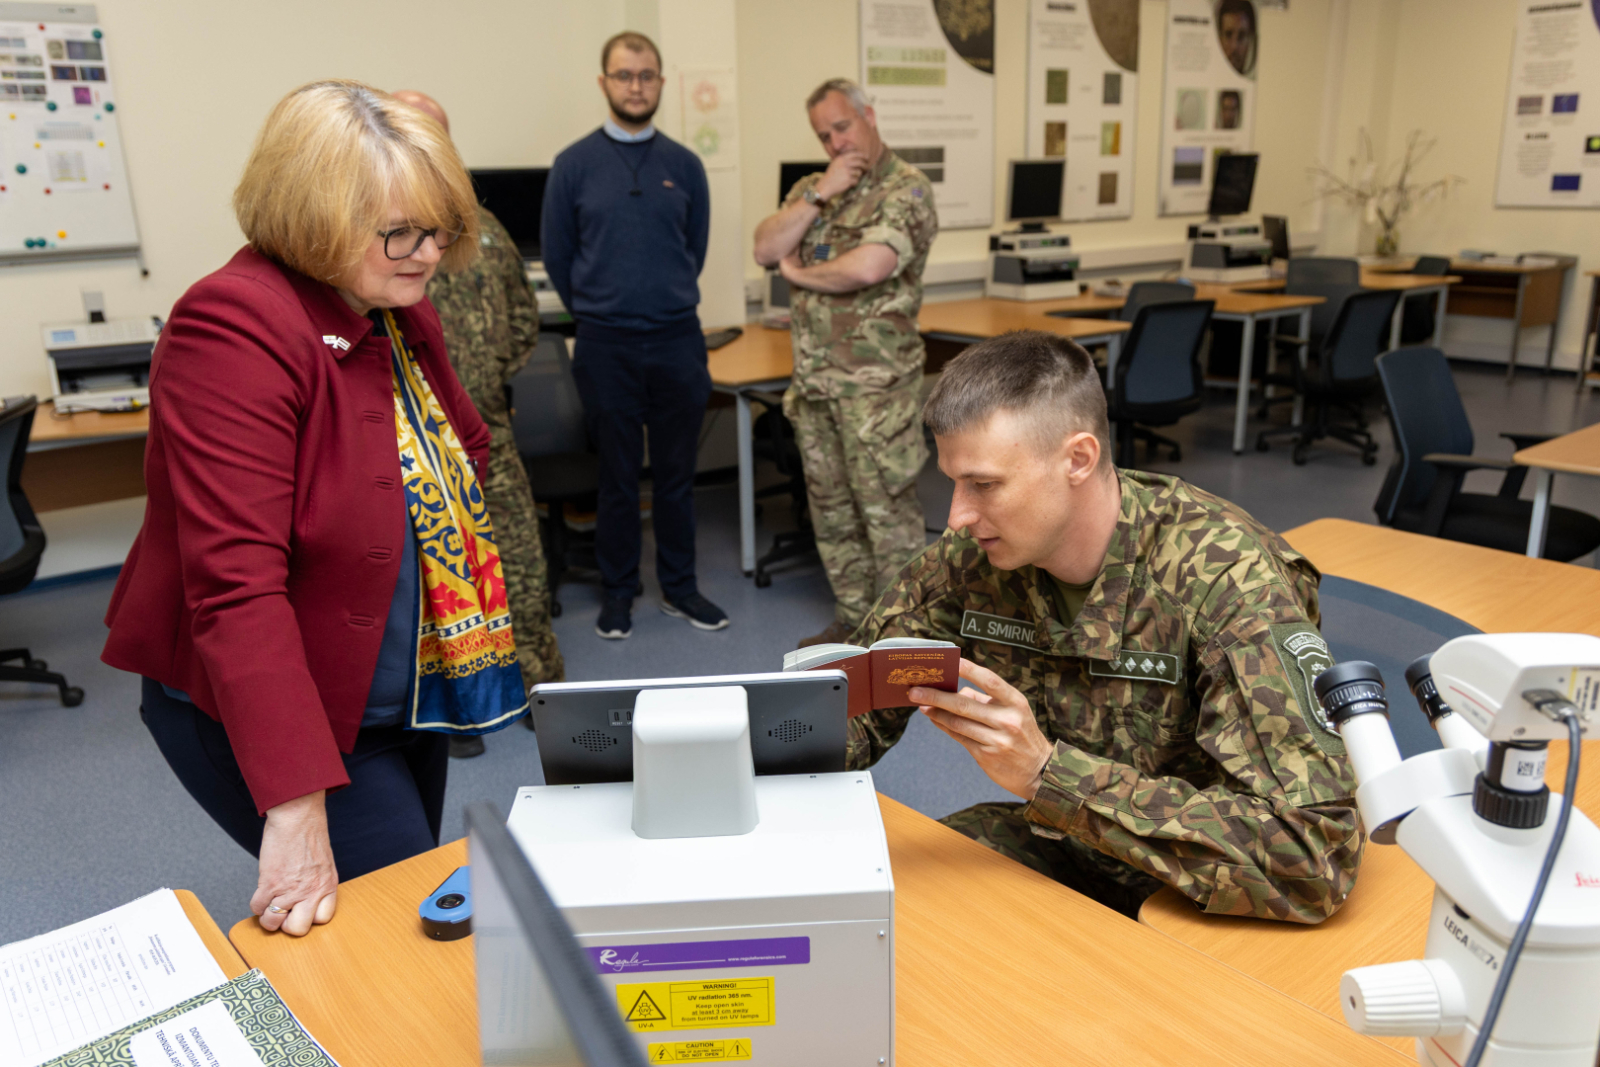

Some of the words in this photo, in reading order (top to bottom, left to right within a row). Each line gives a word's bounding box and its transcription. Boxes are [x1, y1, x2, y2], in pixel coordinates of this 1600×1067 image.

[966, 617, 981, 632] A.
[1351, 703, 1367, 711] LEICA
[1444, 915, 1469, 947] LEICA
[600, 949, 650, 972] Regula
[702, 982, 737, 990] WARNING!
[699, 993, 727, 1001] radiation
[698, 1014, 718, 1022] turned
[155, 1029, 177, 1058] TEHNISKĀ
[189, 1026, 215, 1061] DOKUMENTU
